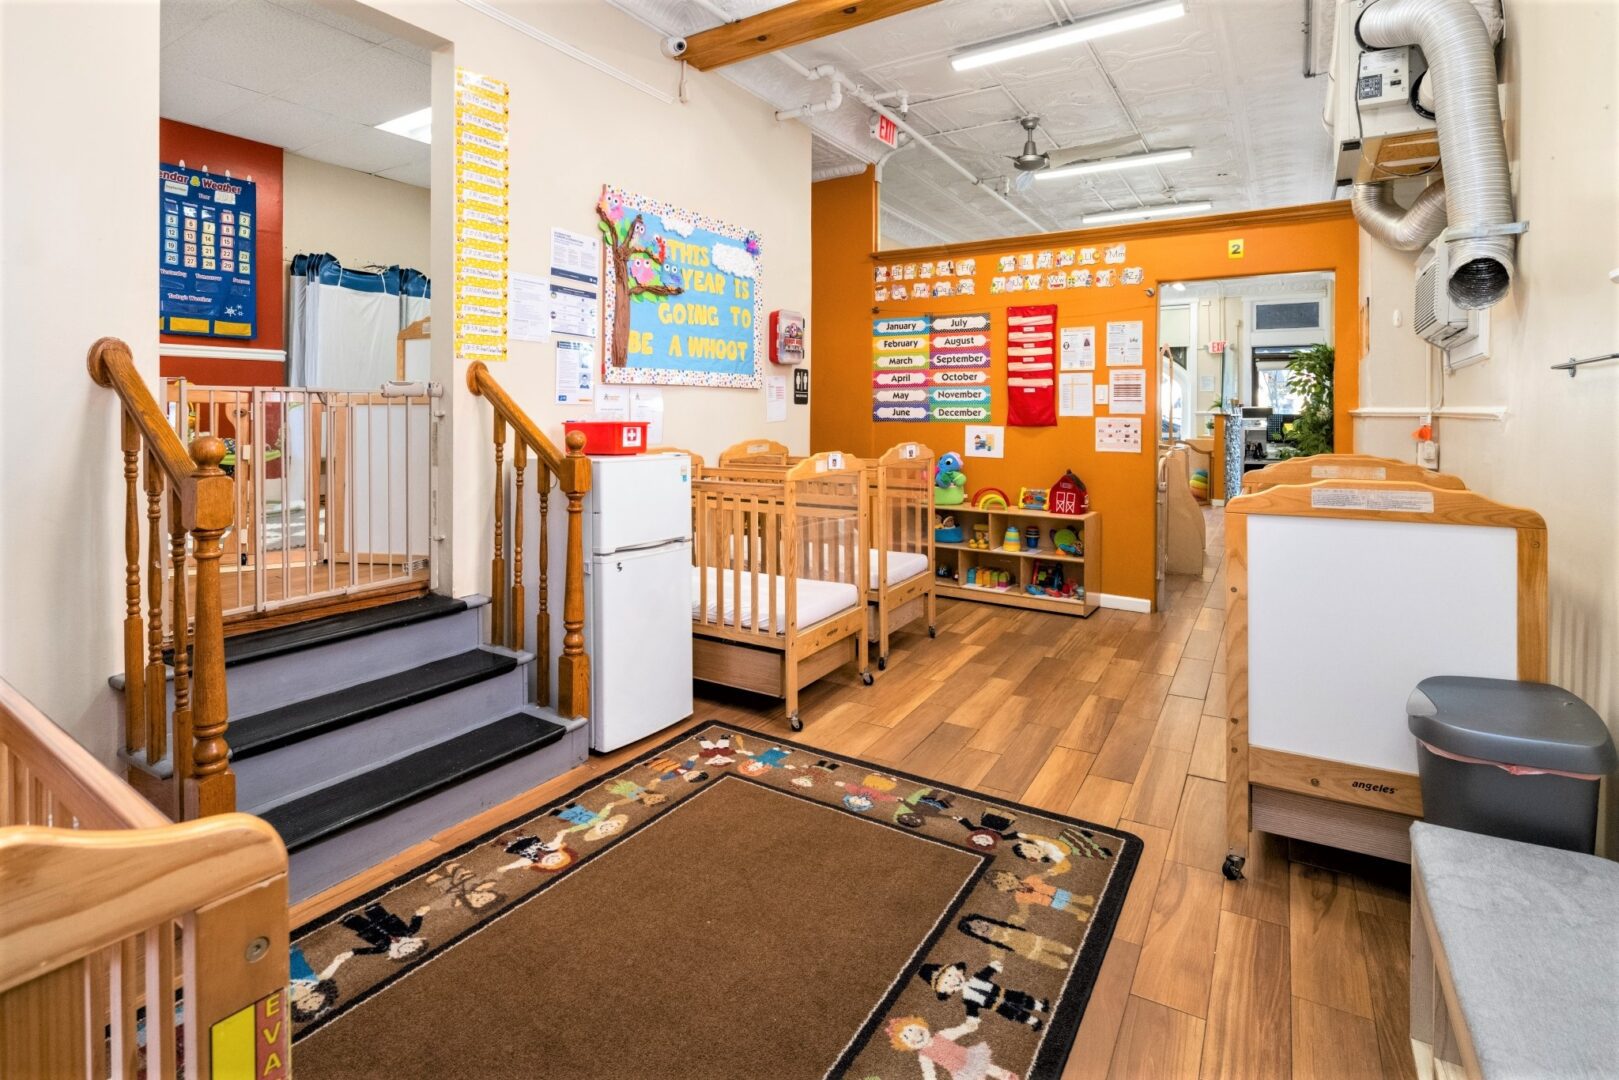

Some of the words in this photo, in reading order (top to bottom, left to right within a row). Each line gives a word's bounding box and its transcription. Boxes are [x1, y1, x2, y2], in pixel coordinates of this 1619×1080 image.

[880, 114, 897, 145] EXIT
[202, 177, 242, 194] Weather
[667, 239, 710, 267] THIS
[1231, 244, 1241, 254] 2
[682, 268, 726, 295] YEAR
[734, 278, 750, 299] IS
[658, 302, 719, 327] GOING
[730, 306, 751, 329] TO
[886, 322, 916, 331] January
[951, 319, 968, 328] July
[628, 330, 654, 355] BE
[668, 335, 683, 357] A
[688, 336, 748, 362] WHOOT
[884, 340, 918, 348] February
[944, 336, 974, 346] August
[888, 357, 913, 365] March
[936, 354, 983, 364] September
[891, 374, 911, 383] April
[892, 392, 909, 400] May
[1352, 781, 1395, 794] angeles
[263, 993, 281, 1080] EVA
